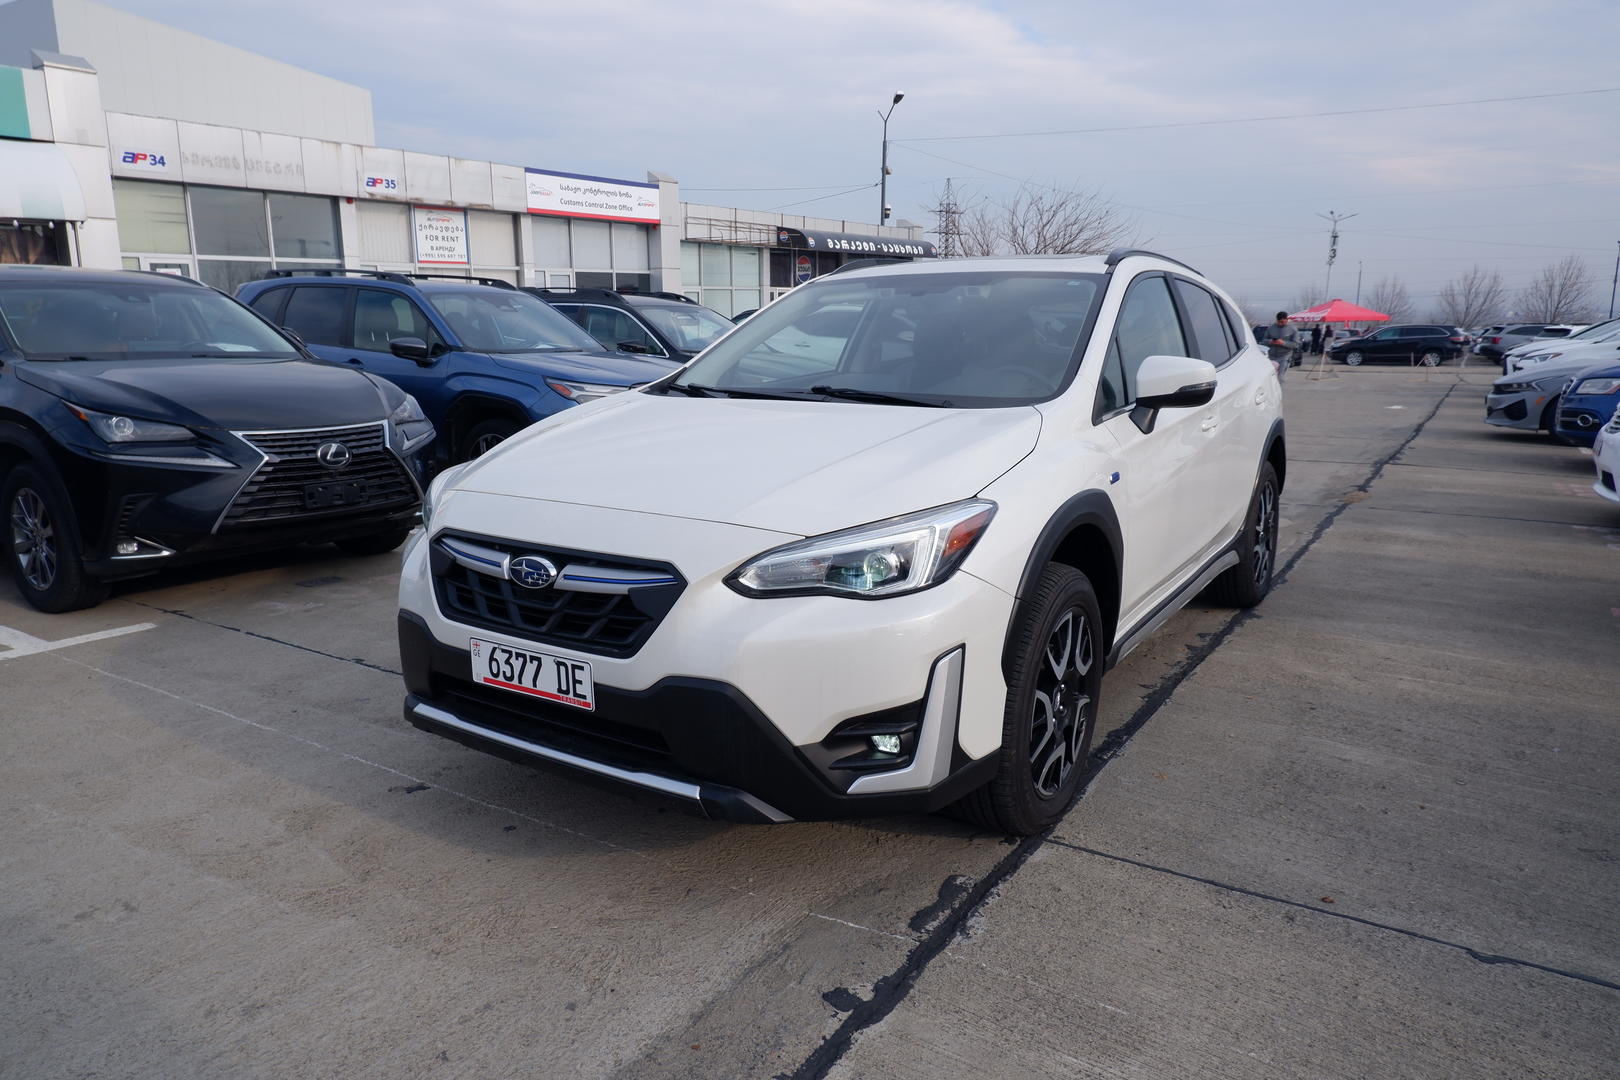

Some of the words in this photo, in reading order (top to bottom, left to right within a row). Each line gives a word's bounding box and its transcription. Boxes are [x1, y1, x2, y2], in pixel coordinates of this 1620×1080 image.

[149, 154, 166, 167] 34
[384, 179, 397, 189] 35
[560, 198, 584, 207] Customs
[585, 201, 604, 209] Control
[618, 204, 633, 212] Office
[425, 234, 440, 242] FOR
[488, 646, 542, 688] 6377
[554, 659, 587, 700] DE
